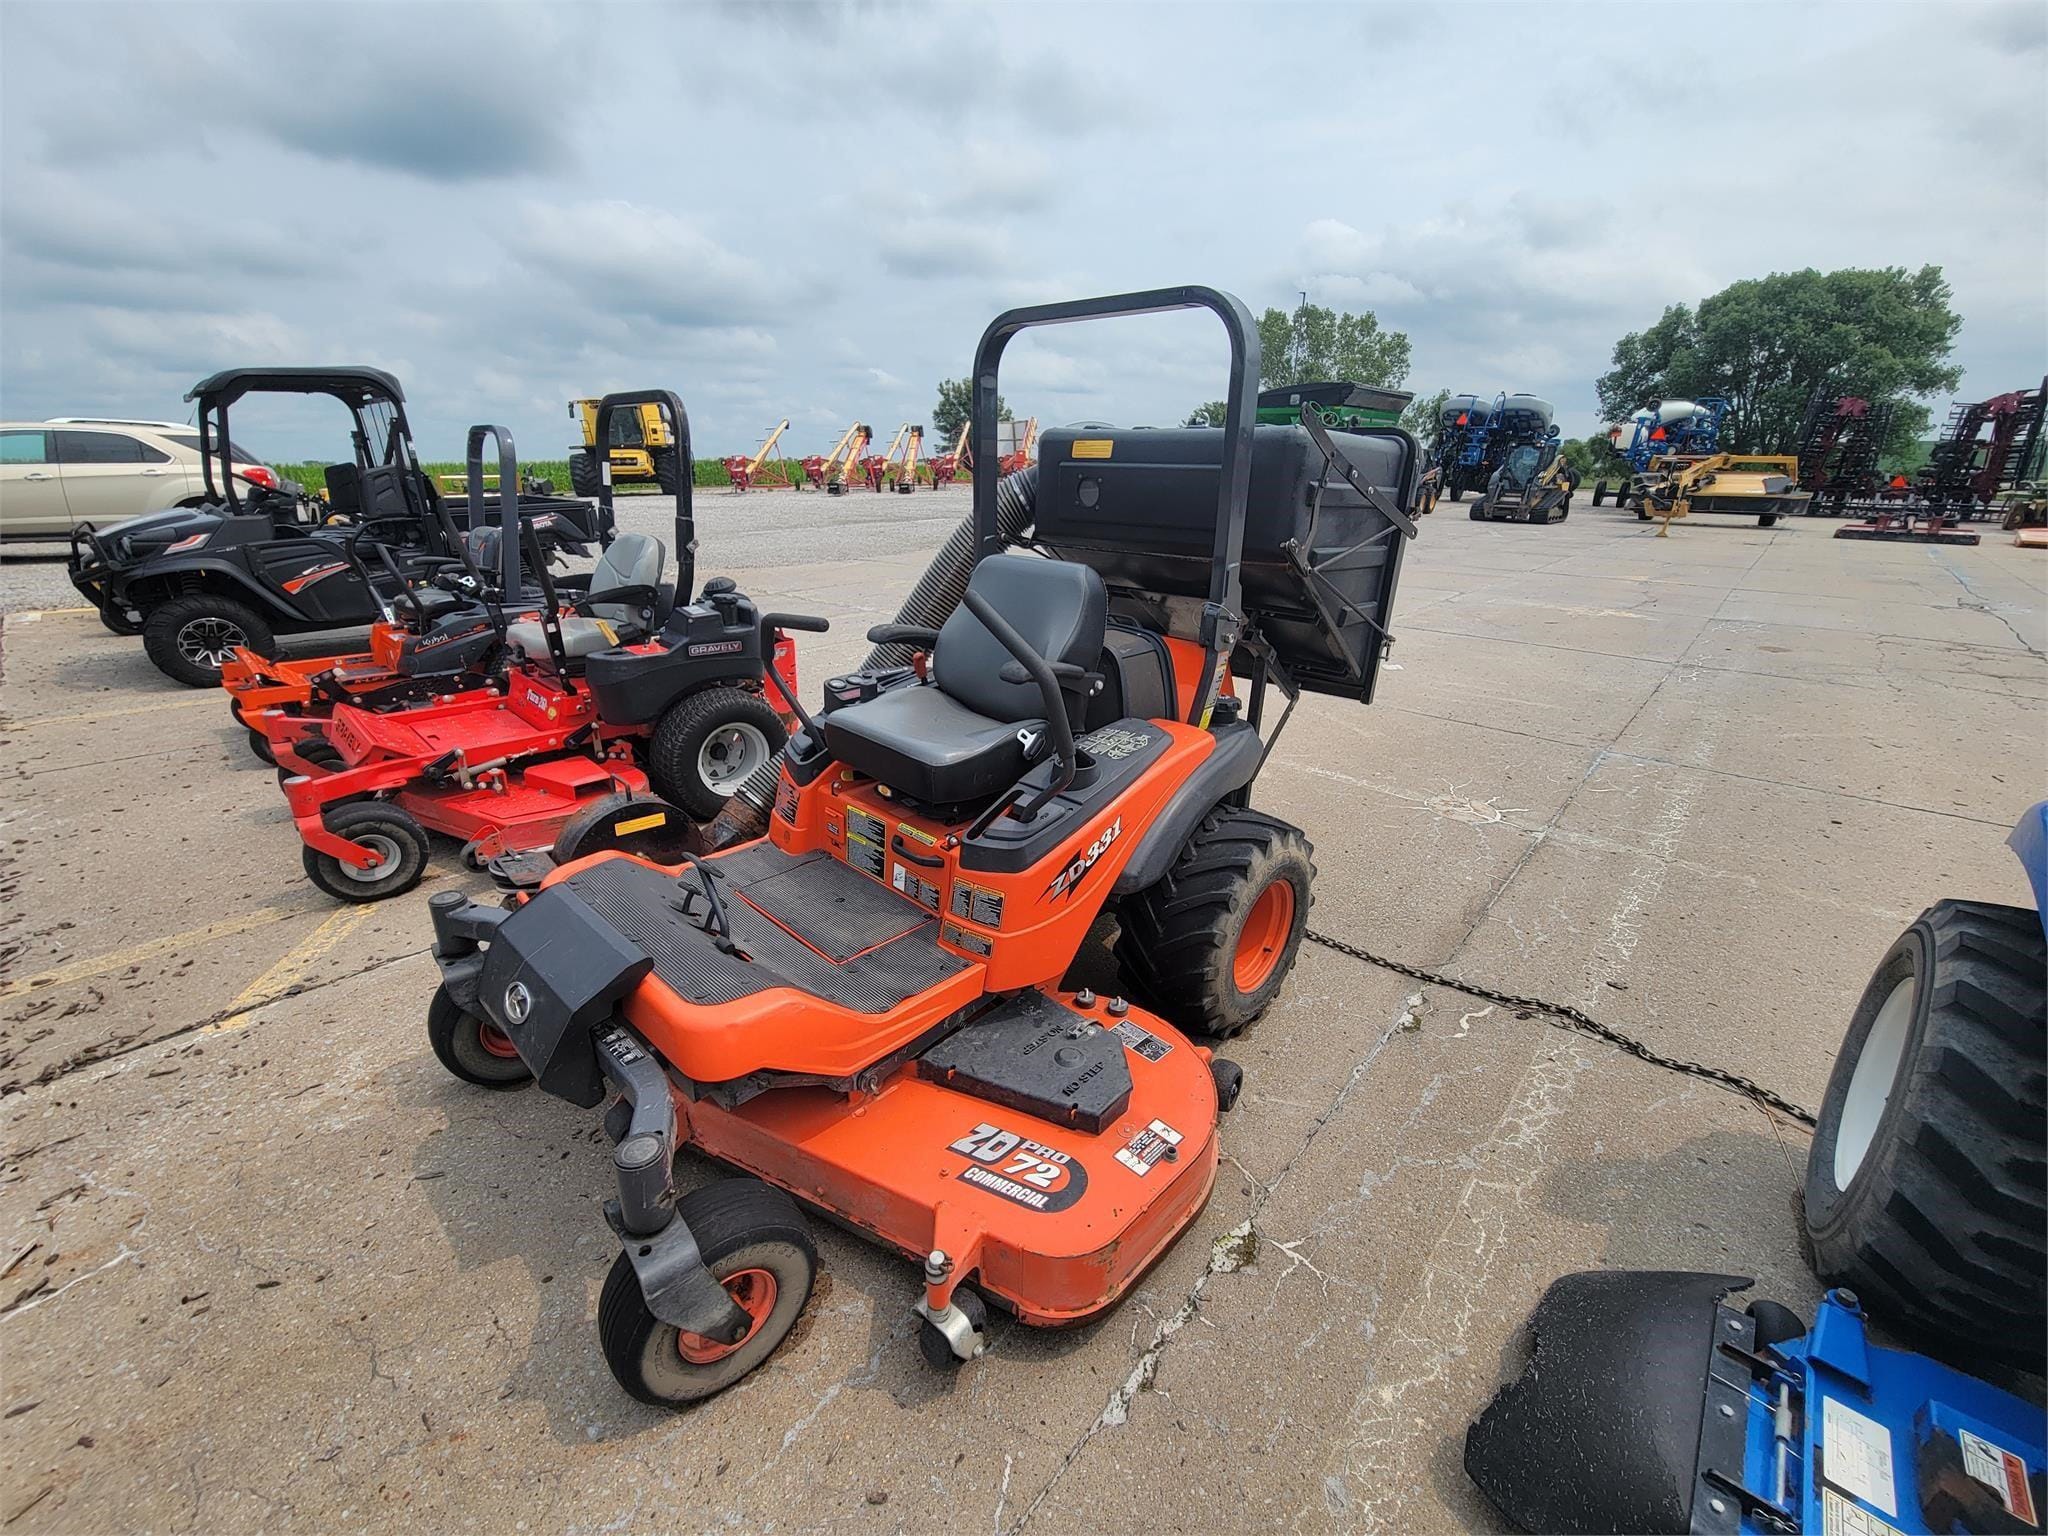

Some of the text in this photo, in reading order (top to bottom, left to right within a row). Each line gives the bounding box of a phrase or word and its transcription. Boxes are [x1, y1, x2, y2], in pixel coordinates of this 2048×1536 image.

[690, 642, 740, 655] GRAVELY
[1049, 814, 1122, 899] ZD331
[1062, 1081, 1080, 1097] NO
[949, 1122, 1072, 1164] ZD PRO
[963, 1166, 1050, 1209] COMMERCIAL
[1002, 1152, 1061, 1188] 72
